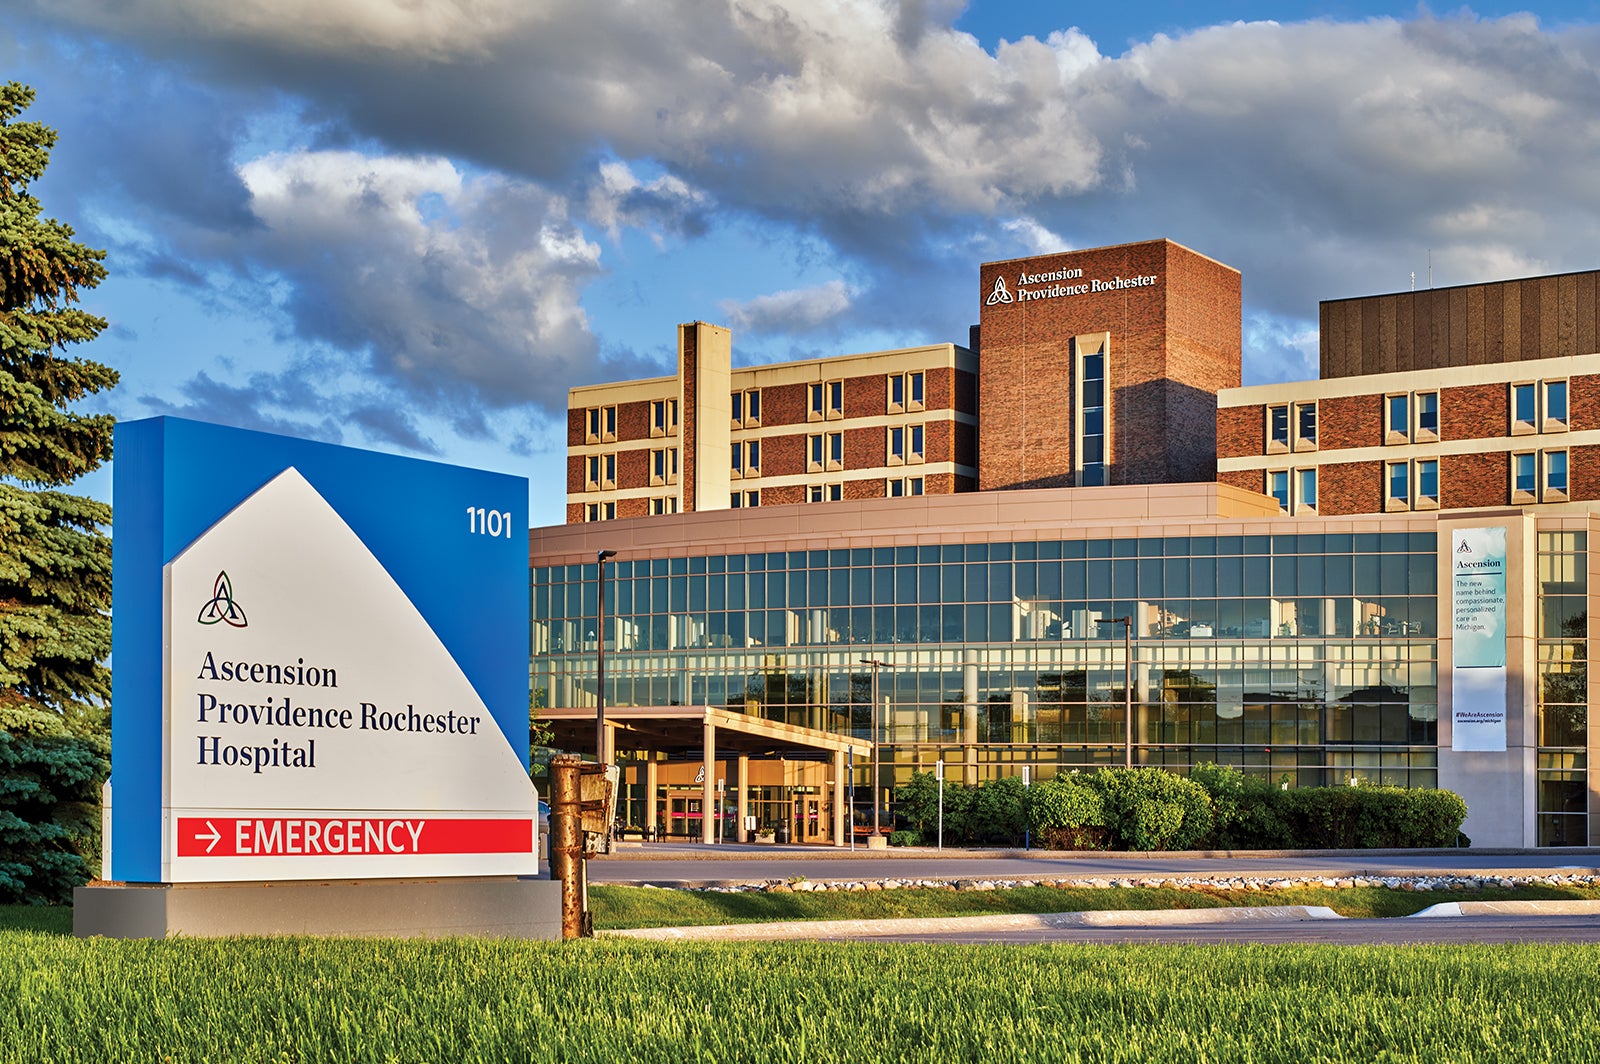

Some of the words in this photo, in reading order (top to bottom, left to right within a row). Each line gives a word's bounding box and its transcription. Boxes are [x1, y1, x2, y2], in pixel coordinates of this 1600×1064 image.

[1017, 267, 1082, 286] Ascension
[1017, 284, 1089, 302] Providence
[1091, 275, 1157, 293] Rochester
[466, 506, 512, 539] 1101
[1457, 559, 1500, 568] Ascension
[1456, 606, 1496, 614] personalized
[1456, 624, 1485, 632] Michigan.
[197, 651, 338, 688] Ascension
[197, 694, 353, 730] Providence
[359, 702, 481, 735] Rochester
[197, 736, 316, 774] Hospital
[235, 819, 426, 854] EMERGENCY
